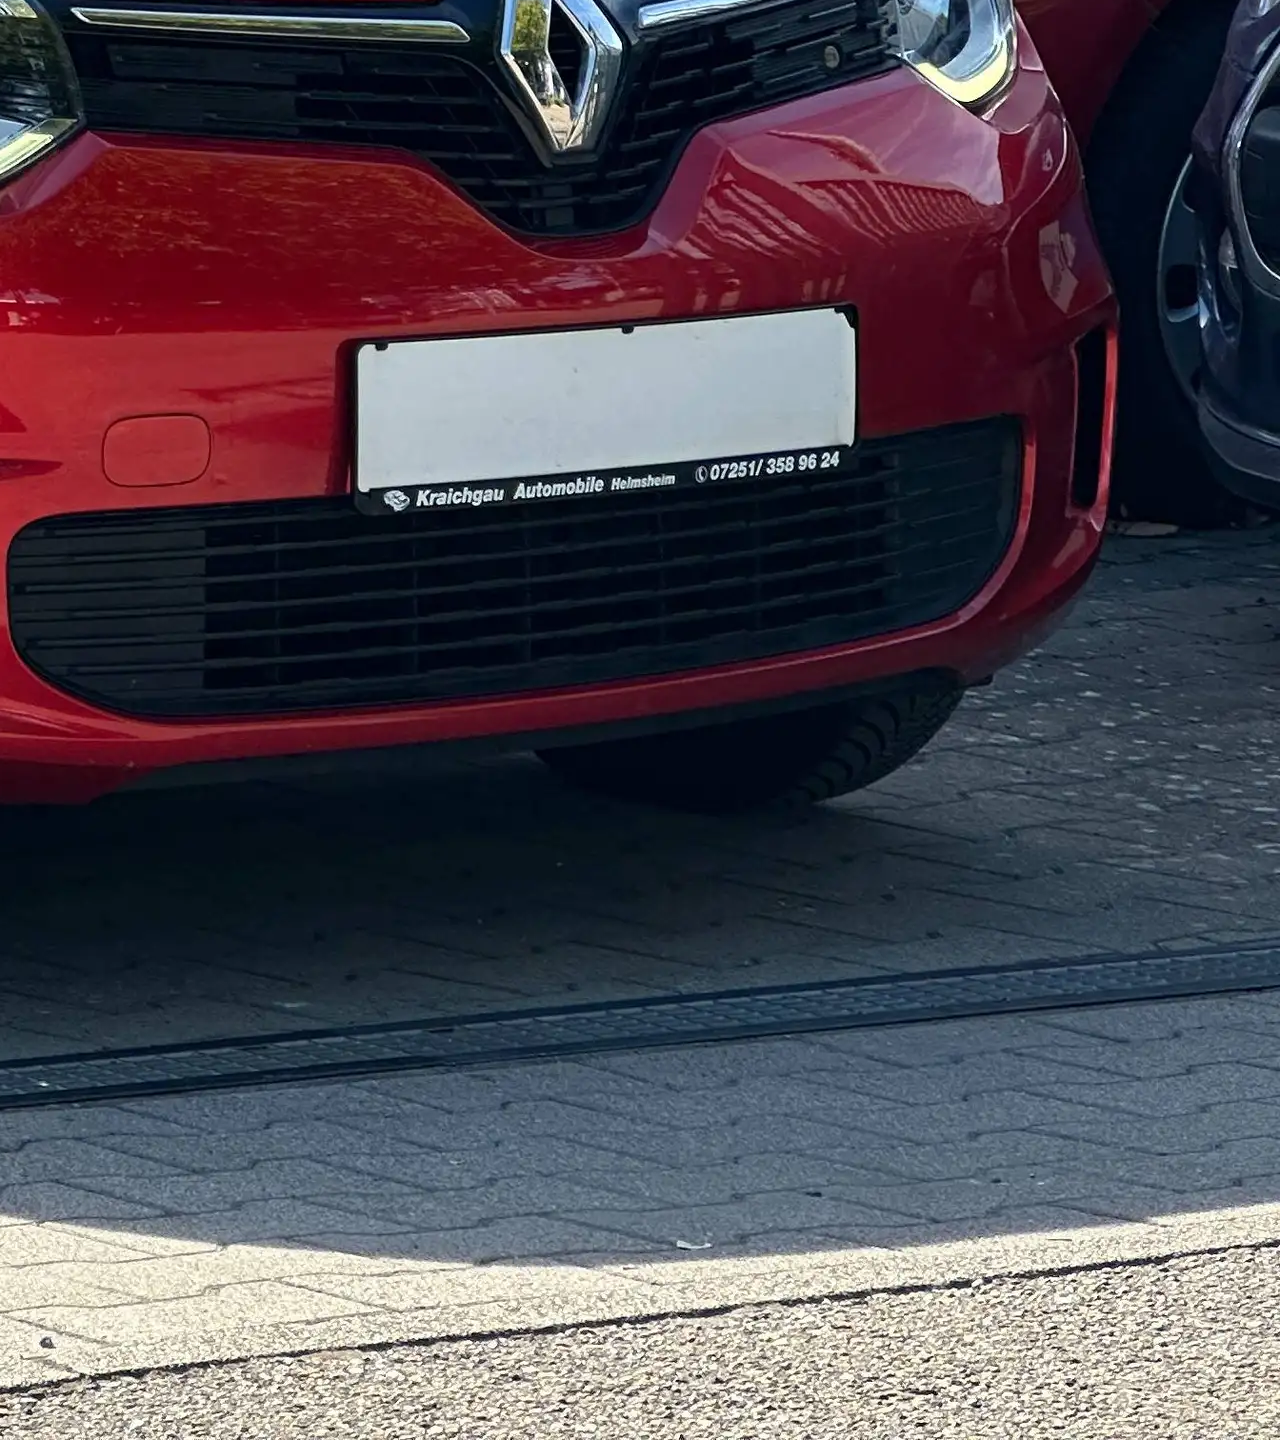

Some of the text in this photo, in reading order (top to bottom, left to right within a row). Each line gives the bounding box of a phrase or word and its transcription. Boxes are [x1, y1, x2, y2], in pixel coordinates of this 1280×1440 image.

[415, 486, 505, 507] Kraichgau
[513, 475, 604, 501] Automobile
[709, 458, 763, 482] 07251/
[765, 454, 795, 475] 358
[798, 453, 818, 471] 96
[820, 450, 841, 469] 24
